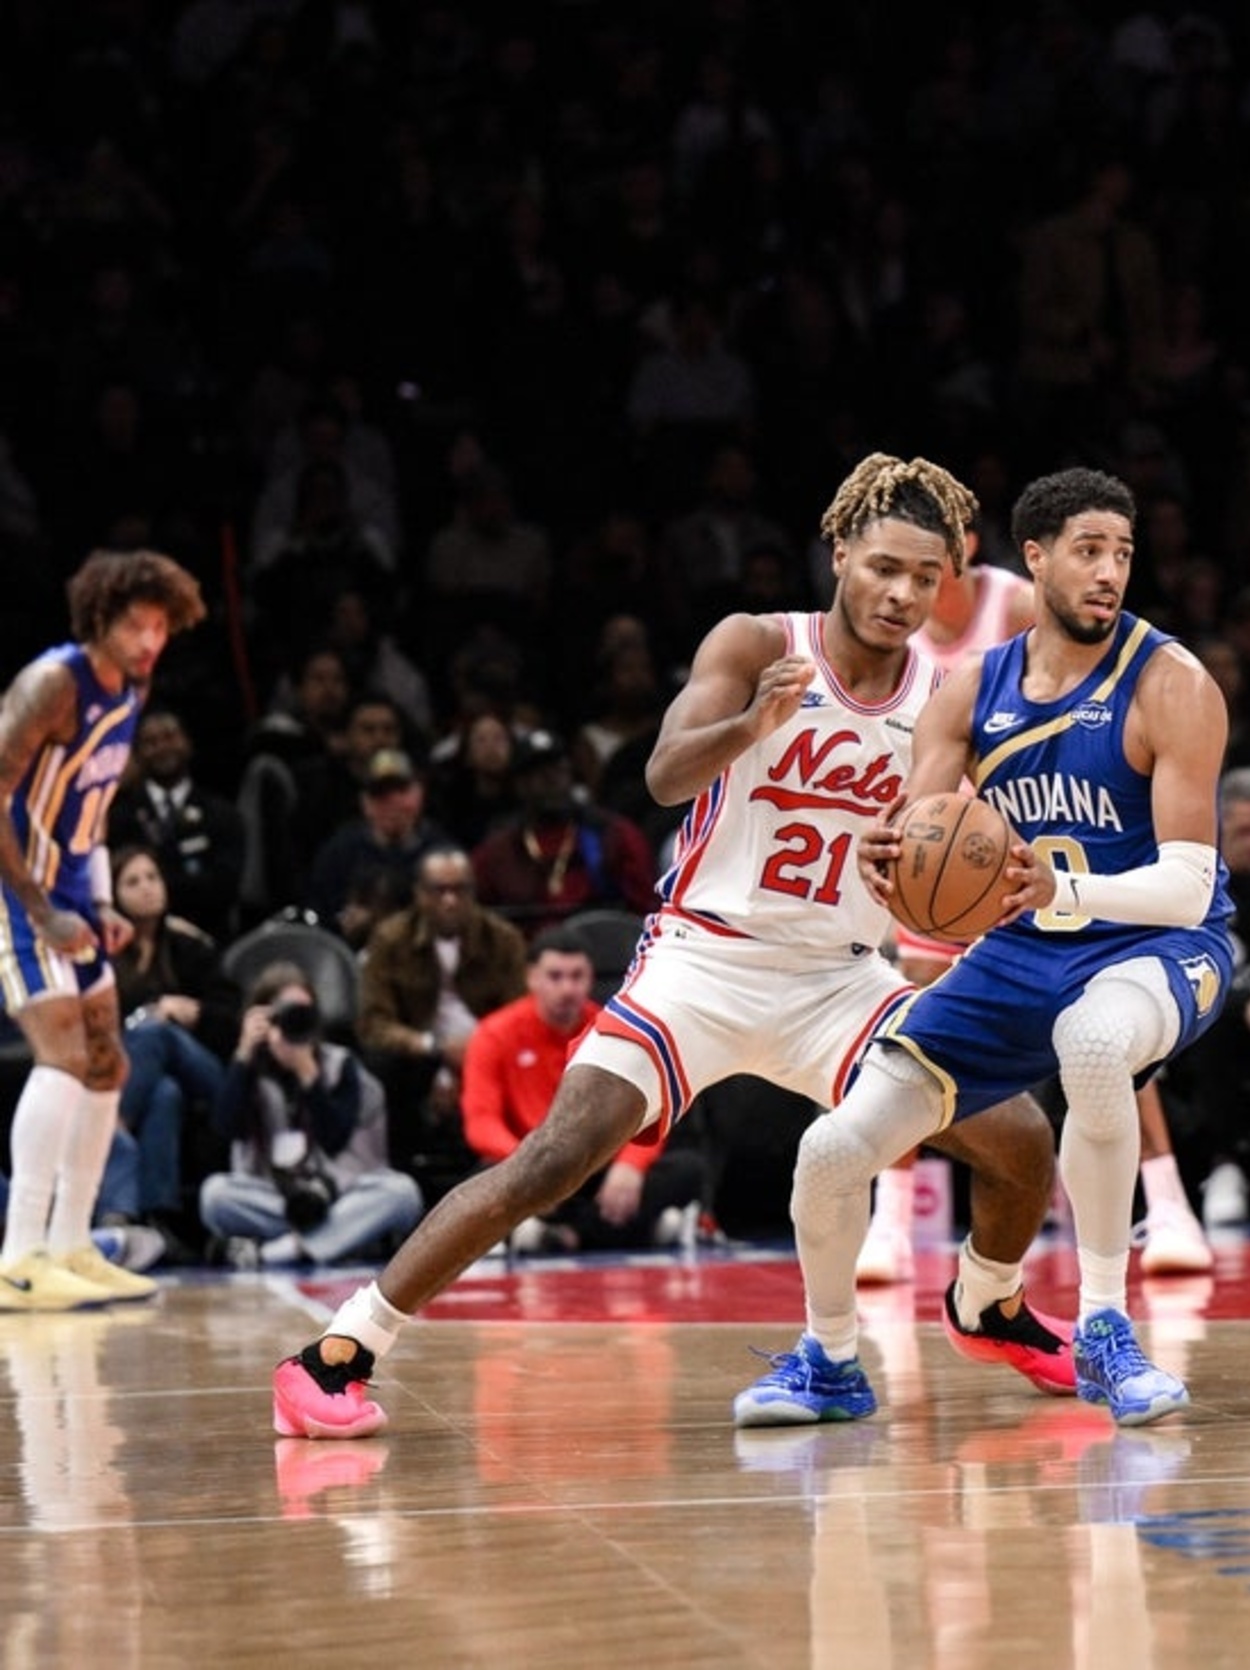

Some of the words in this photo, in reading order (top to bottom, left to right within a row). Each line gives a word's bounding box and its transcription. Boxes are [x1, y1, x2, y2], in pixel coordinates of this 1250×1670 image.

[768, 728, 902, 803] Nets
[984, 772, 1123, 832] INDIANA
[760, 822, 852, 906] 21
